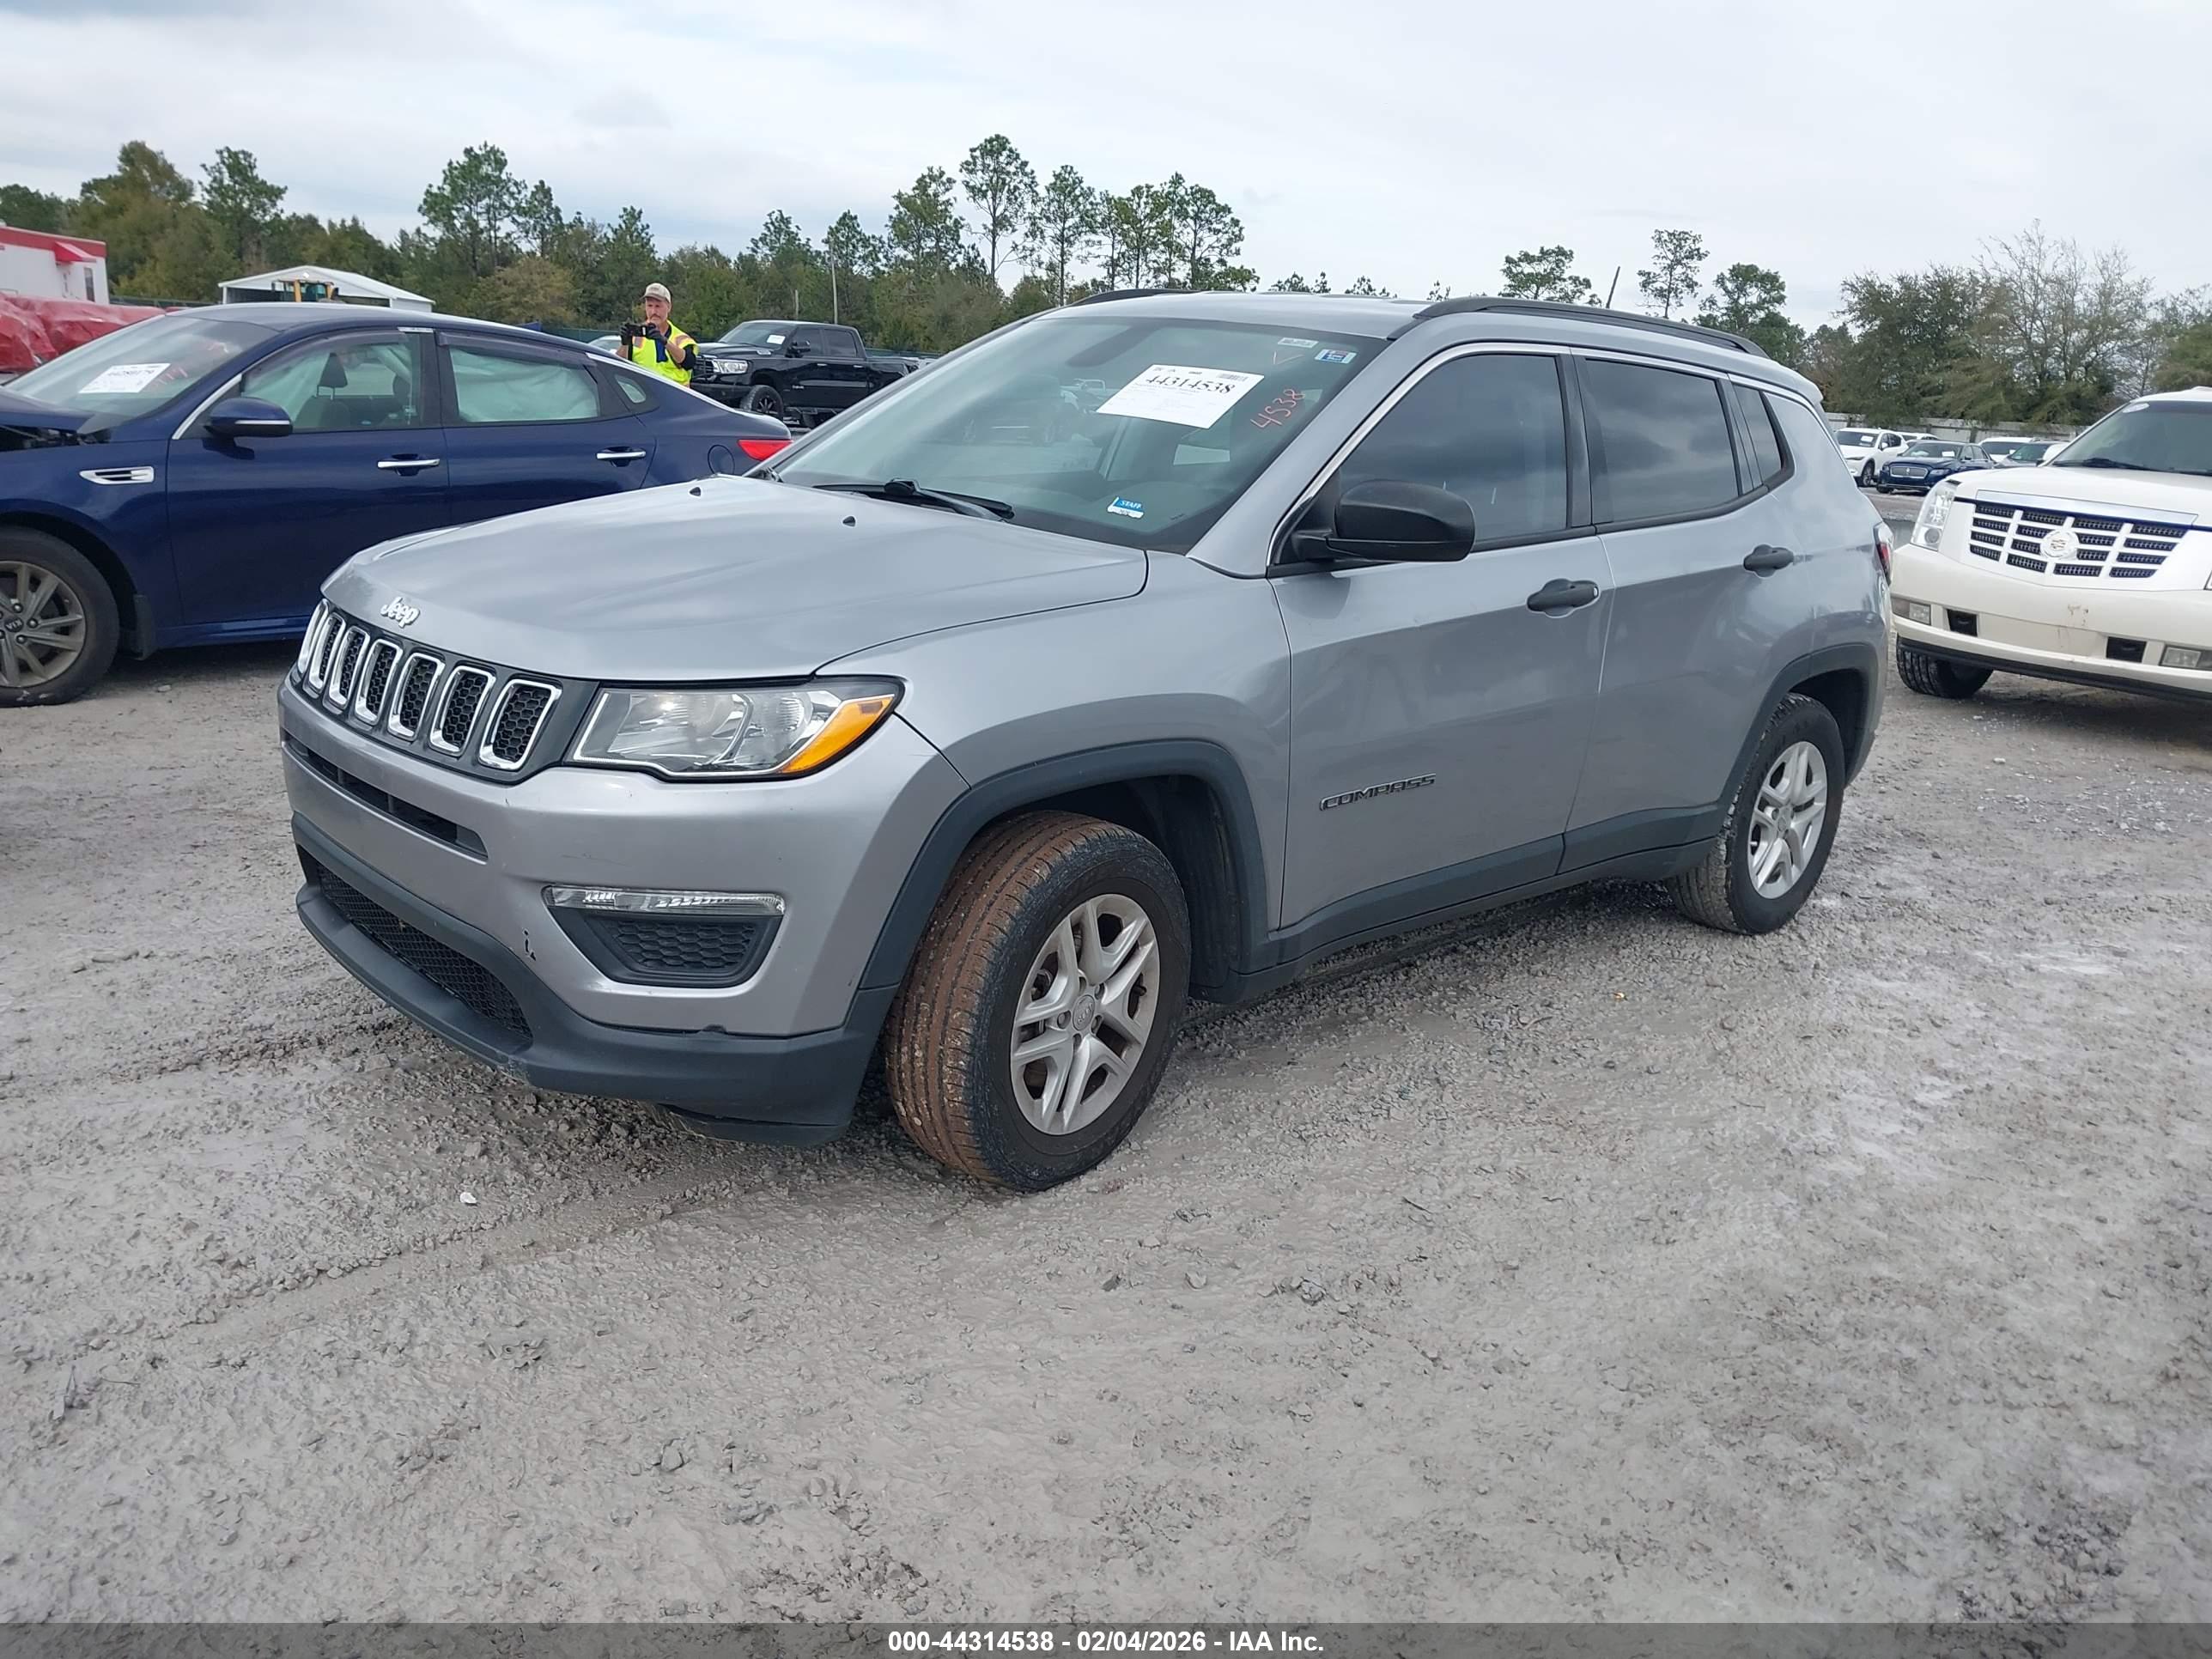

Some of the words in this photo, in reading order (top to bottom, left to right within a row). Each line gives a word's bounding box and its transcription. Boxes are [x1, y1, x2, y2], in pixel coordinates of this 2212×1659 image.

[1146, 374, 1236, 394] 44314538
[1249, 388, 1305, 428] 4538
[380, 596, 421, 629] Jeep
[1319, 773, 1437, 811] COMPASS
